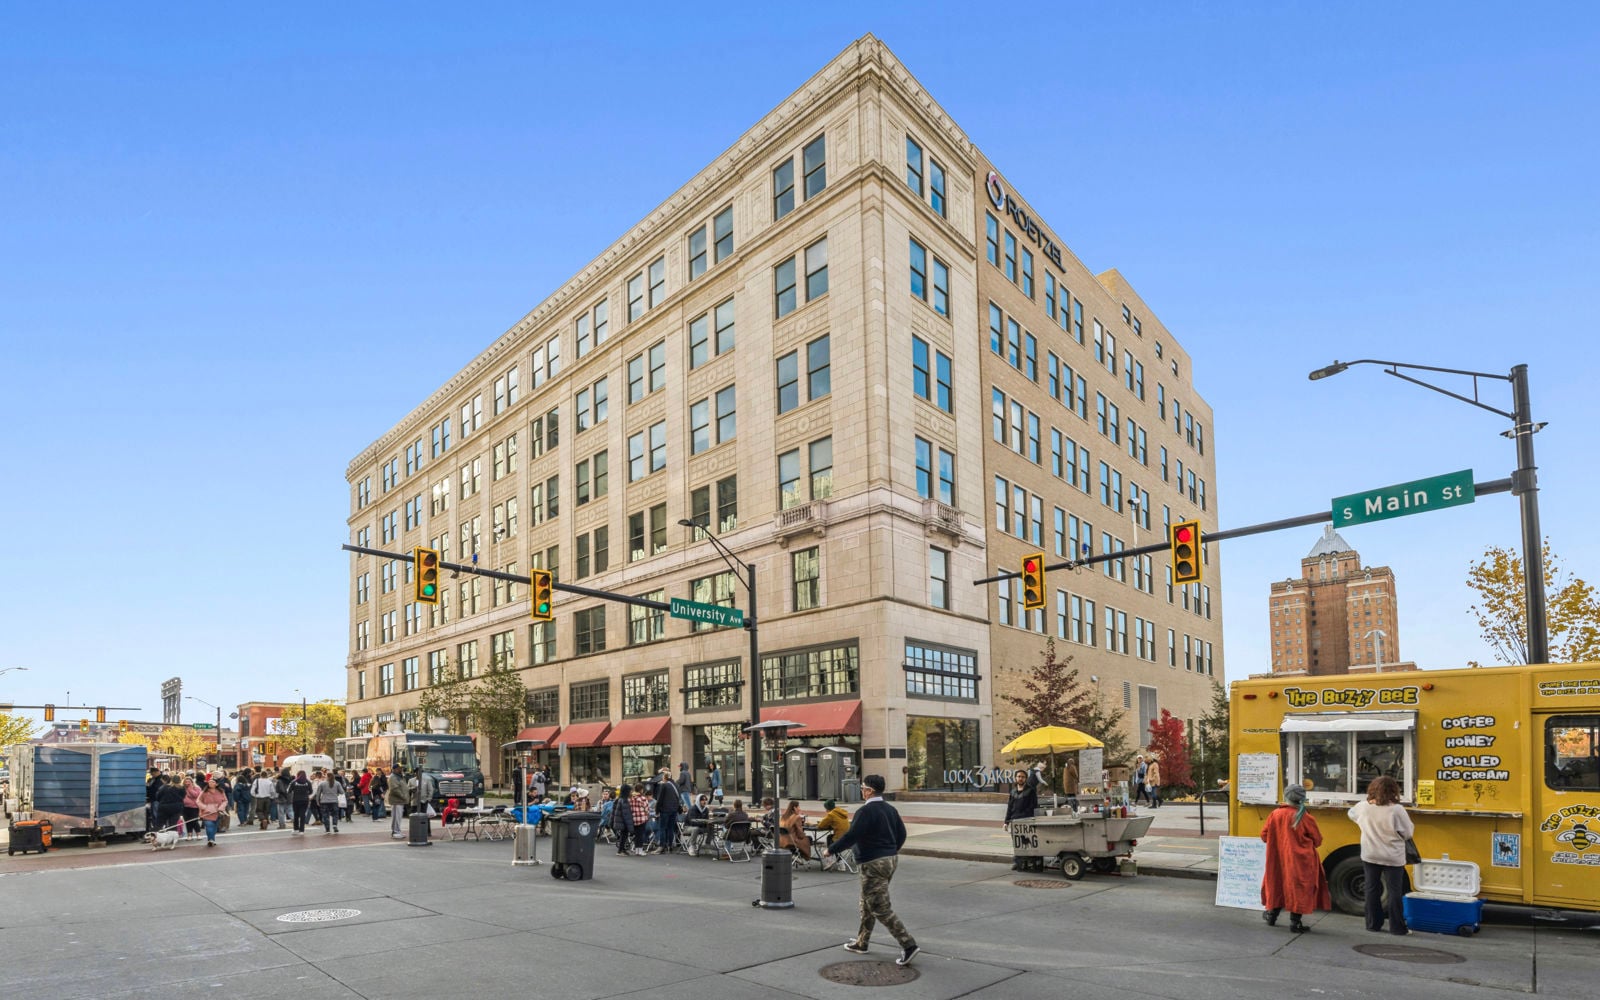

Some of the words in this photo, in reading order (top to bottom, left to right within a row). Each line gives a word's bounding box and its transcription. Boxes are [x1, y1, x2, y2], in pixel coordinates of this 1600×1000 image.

[1006, 194, 1066, 273] ROETZEL
[1343, 507, 1353, 520] S
[1364, 490, 1428, 516] Main
[1442, 485, 1462, 500] St
[672, 602, 726, 623] University
[729, 616, 741, 624] Ave
[943, 769, 973, 784] LOCK
[972, 765, 986, 788] 3
[986, 769, 1030, 785] AKR
[1014, 824, 1037, 834] STRAY
[1014, 835, 1038, 848] DG
